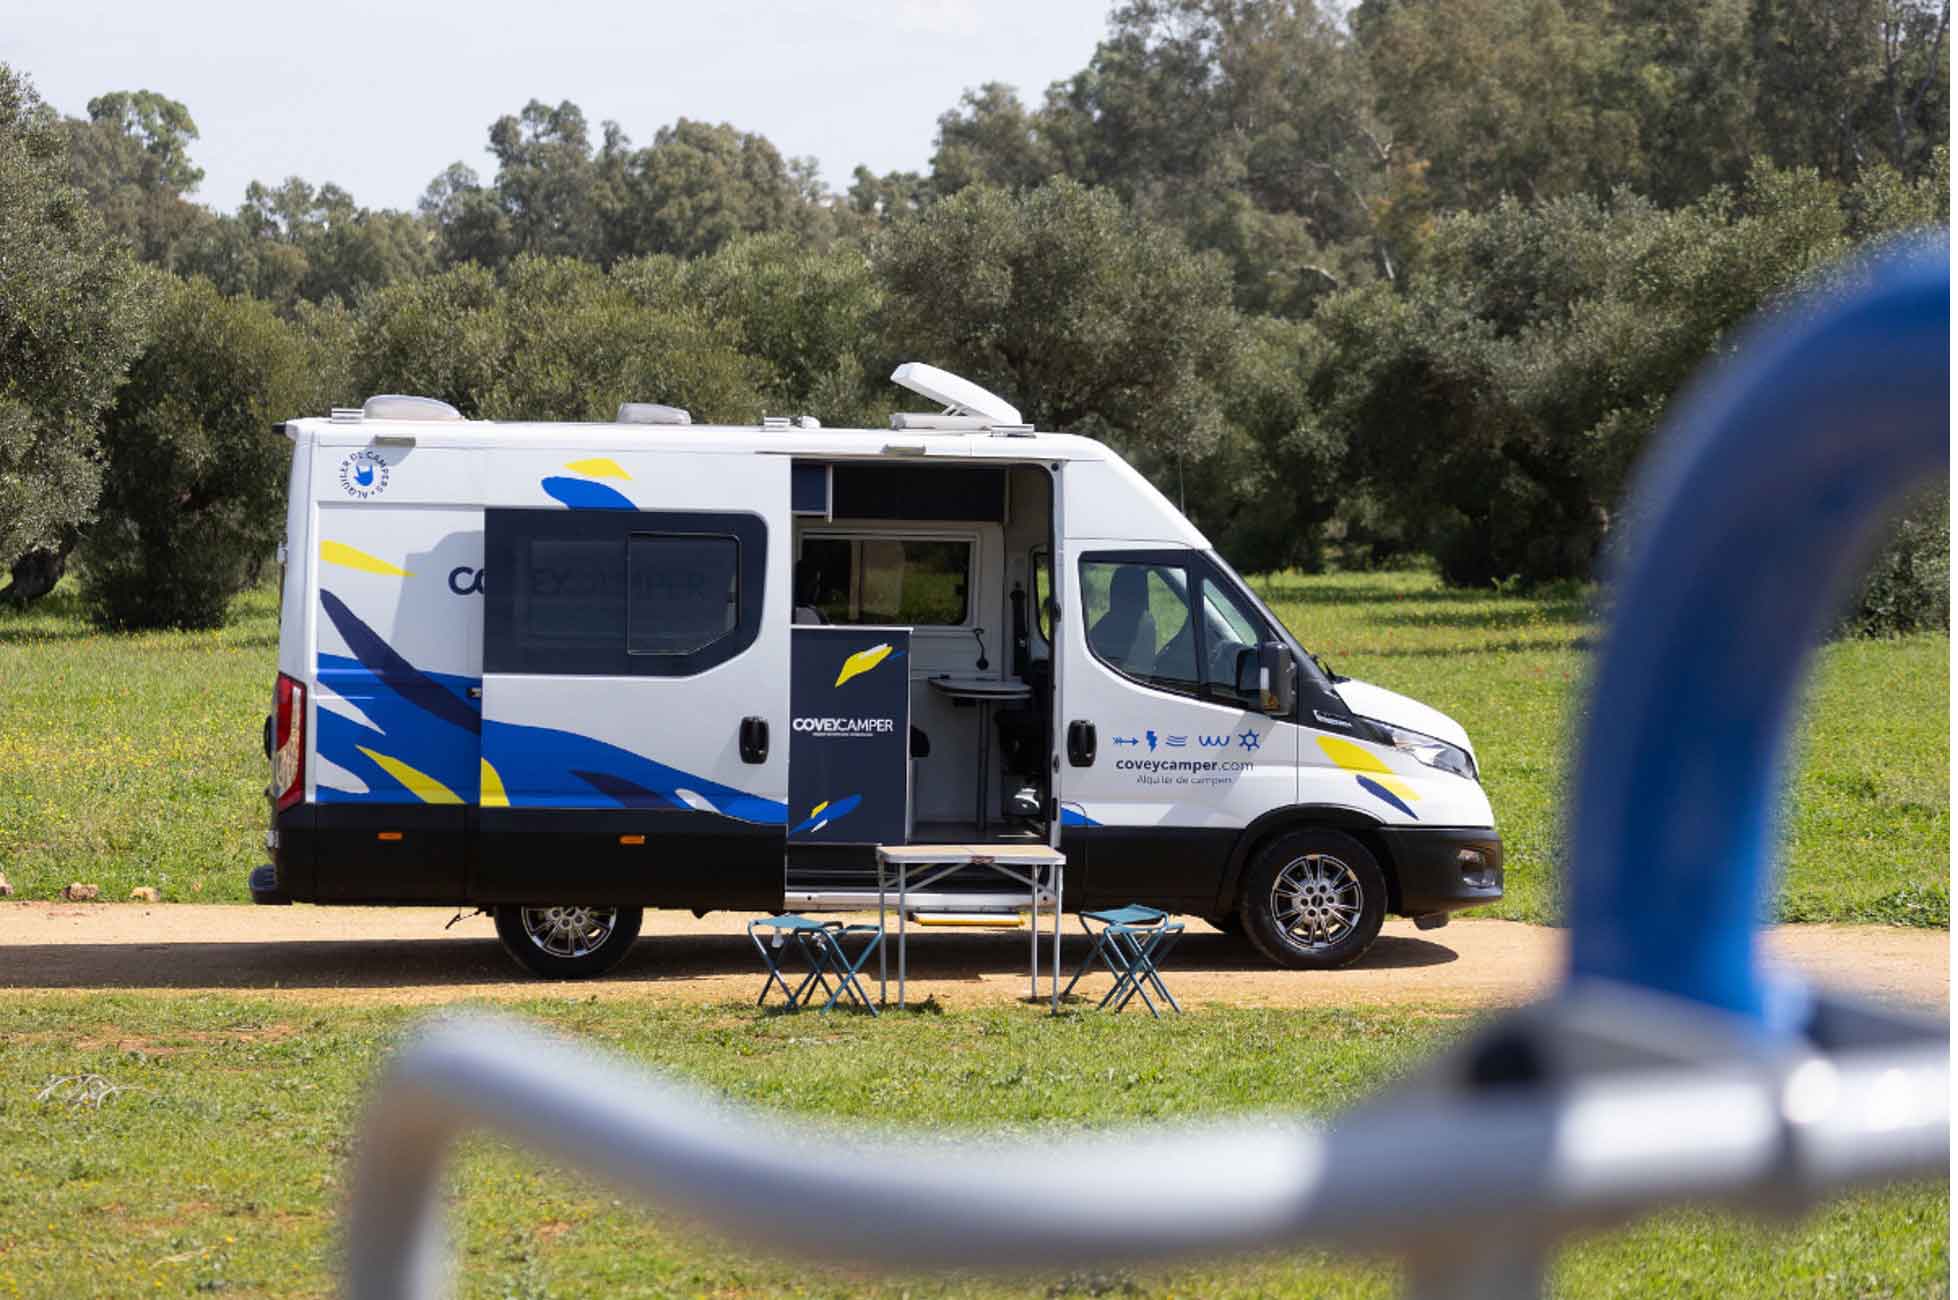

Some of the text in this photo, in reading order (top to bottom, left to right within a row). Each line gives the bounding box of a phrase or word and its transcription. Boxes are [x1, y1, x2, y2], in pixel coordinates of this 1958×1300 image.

[792, 717, 894, 732] COVEYCAMPER
[1115, 758, 1255, 774] coveycamper.com
[1176, 775, 1189, 784] de
